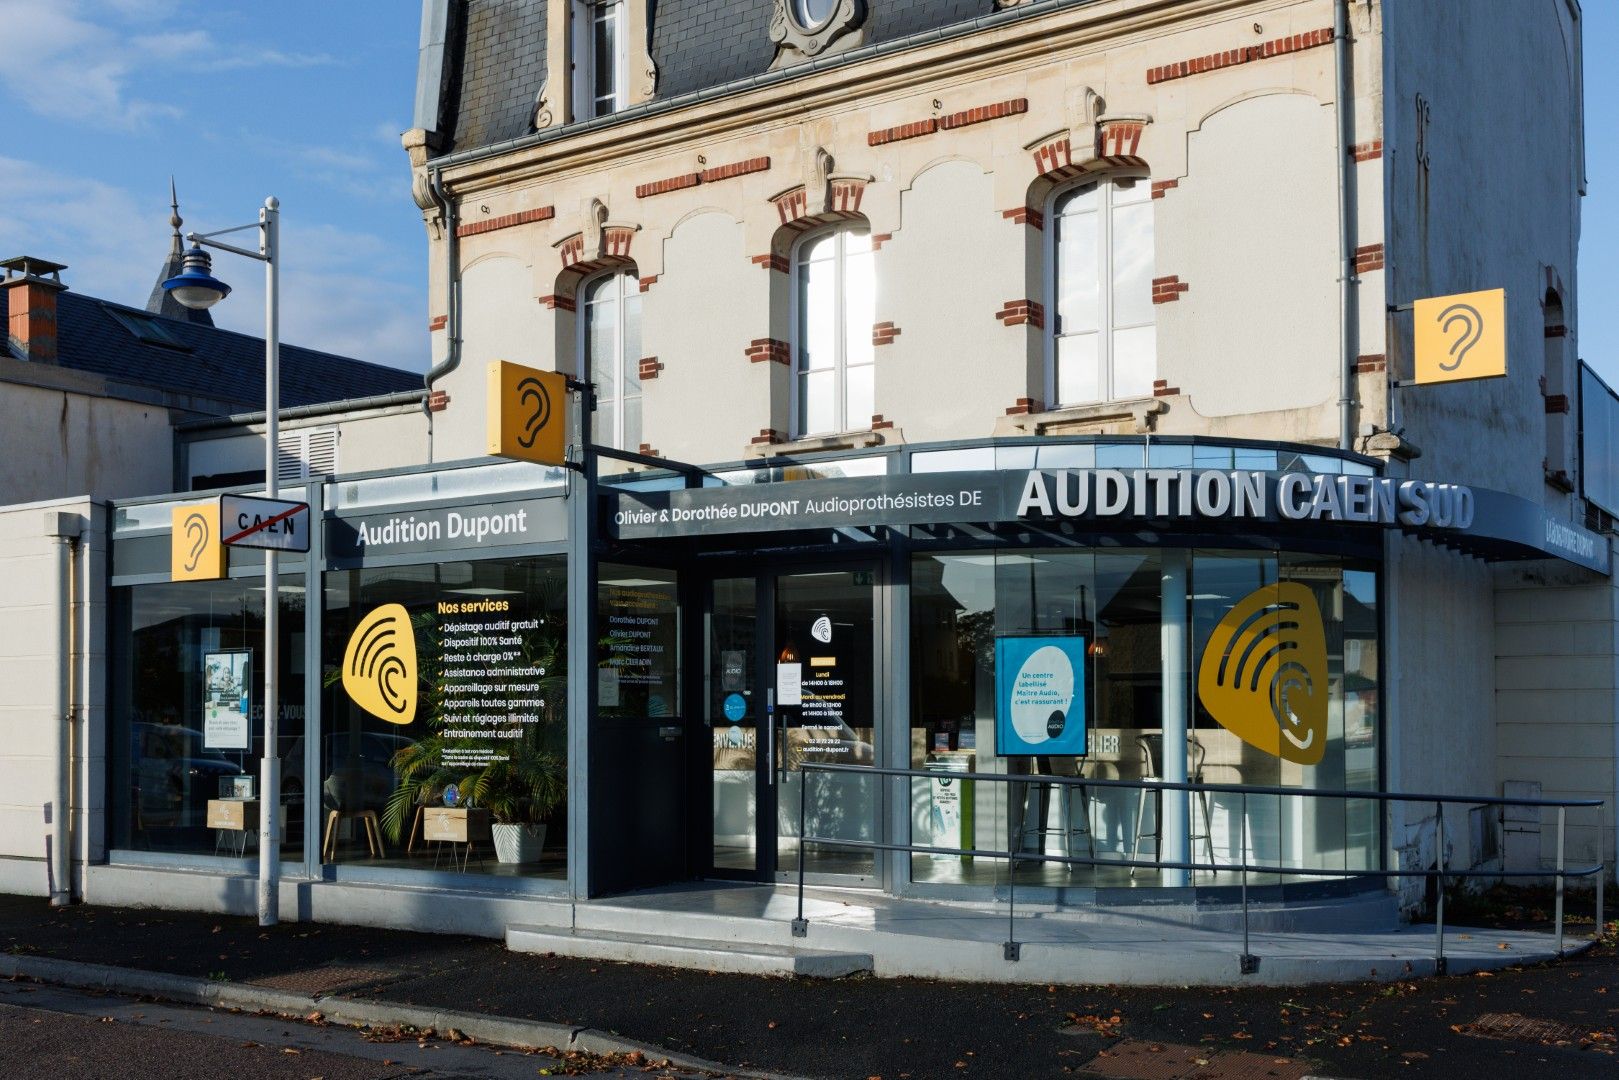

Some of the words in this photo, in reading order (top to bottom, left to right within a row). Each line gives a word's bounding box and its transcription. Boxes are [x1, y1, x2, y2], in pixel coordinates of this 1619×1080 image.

[1017, 469, 1266, 518] AUDITION
[1278, 472, 1396, 523] CAEN
[1398, 480, 1475, 529] SUD
[615, 508, 656, 525] Olivier
[659, 509, 669, 523] &
[672, 503, 737, 522] Dorothée
[740, 500, 799, 518] DUPONT
[804, 490, 955, 516] Audioprothésistes
[959, 490, 982, 507] DE
[237, 512, 295, 535] CAEN
[356, 515, 441, 546] Audition
[447, 508, 527, 542] Dupont
[438, 602, 459, 614] Nos
[461, 598, 509, 612] services
[444, 622, 483, 634] Dépistage
[484, 620, 510, 631] auditif
[511, 619, 539, 632] gratuit
[636, 617, 659, 625] DUPONT
[444, 636, 479, 649] Dispositif
[479, 636, 498, 646] 100%
[499, 635, 523, 645] Santé
[444, 653, 465, 662] Reste
[466, 652, 472, 661] à
[472, 652, 501, 663] charge
[444, 668, 485, 678] Assistance
[487, 666, 545, 677] administrative
[443, 683, 493, 694] Appareillage
[494, 684, 507, 692] sur
[508, 683, 539, 692] mesure
[1017, 689, 1037, 697] Maître
[443, 698, 480, 709] Appareils
[481, 698, 507, 708] toutes
[508, 699, 545, 709] gammes
[443, 713, 462, 723] Suivi
[462, 714, 471, 723] et
[472, 713, 507, 725] réglages
[508, 712, 539, 723] illimités
[497, 728, 524, 738] auditif
[803, 746, 849, 754] audition-dupont.fr
